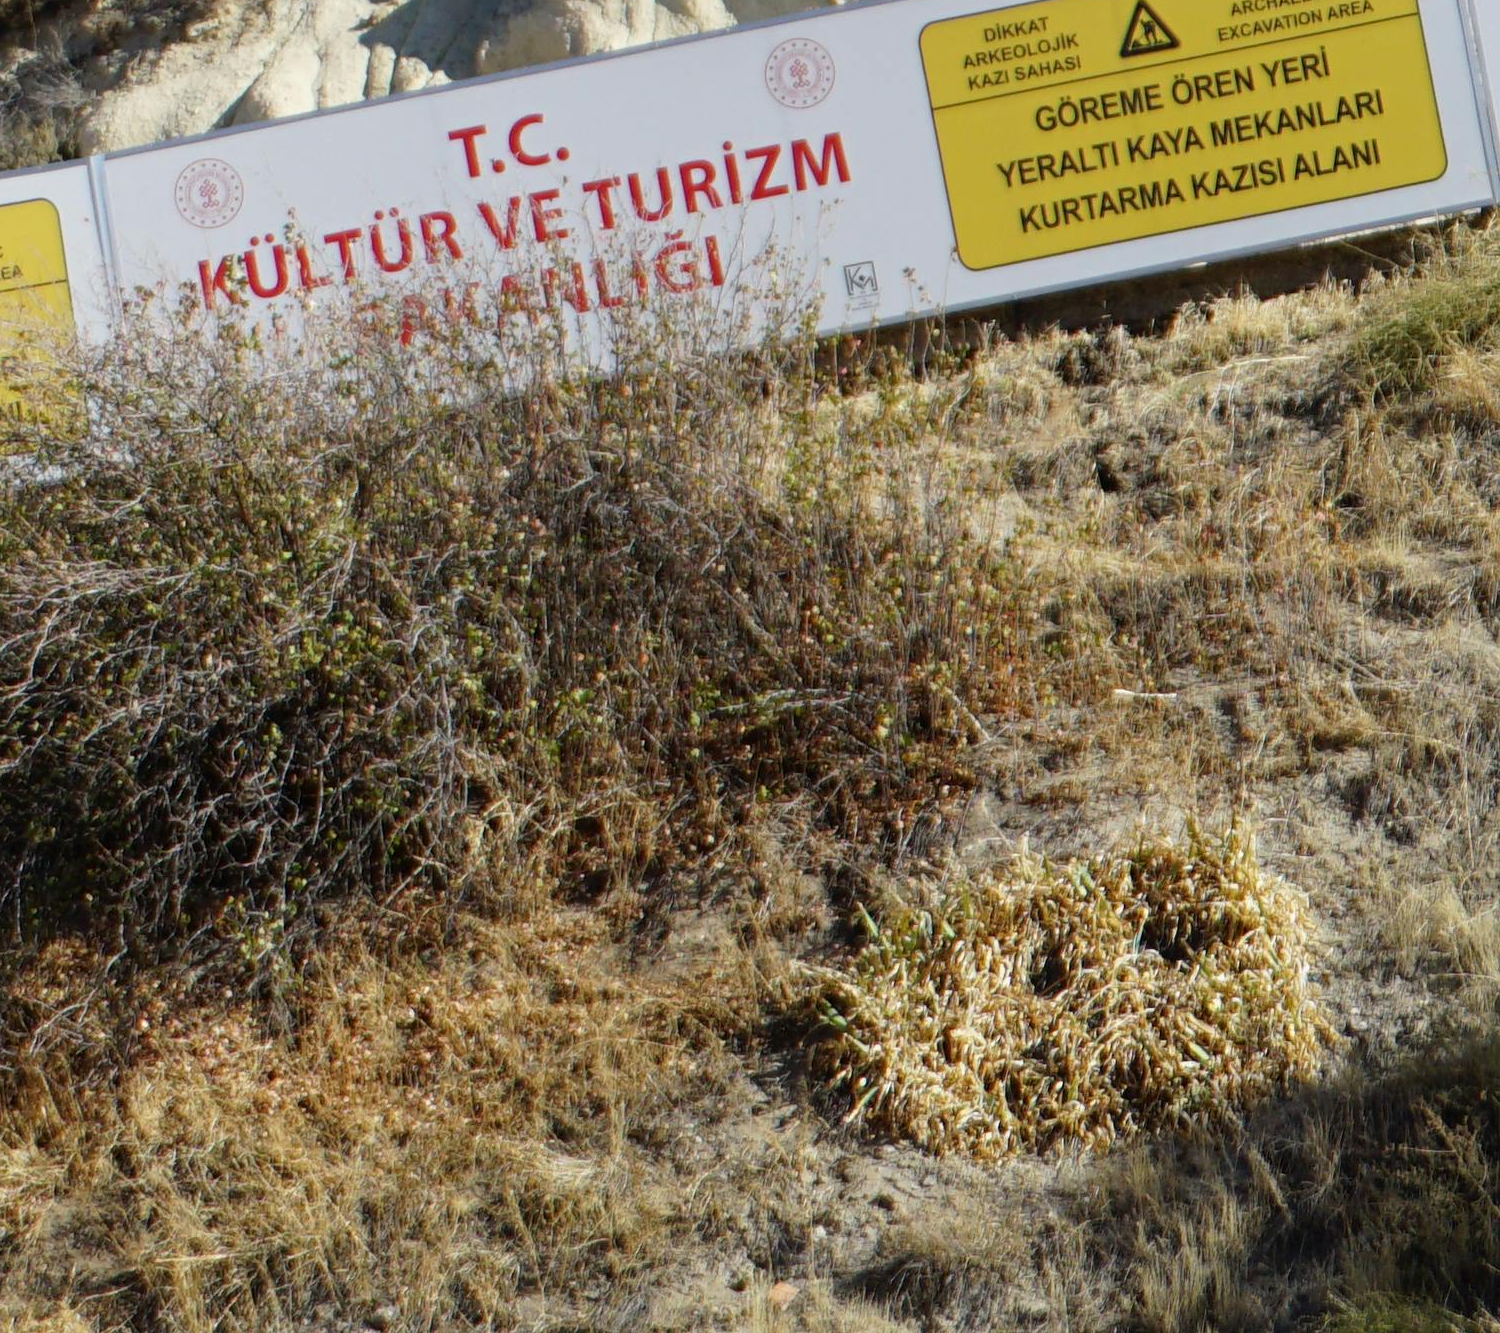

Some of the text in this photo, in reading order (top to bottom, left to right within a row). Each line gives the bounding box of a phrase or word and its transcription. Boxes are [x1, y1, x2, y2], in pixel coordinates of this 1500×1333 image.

[963, 34, 1078, 69] ARKEOLOJİK
[983, 17, 1047, 42] DİKKAT
[1217, 0, 1373, 41] EXCAVATION AREA
[968, 56, 1080, 90] KAZI SAHASI
[1035, 46, 1330, 132] GÖREME ÖREN YERİ
[448, 114, 569, 178] T.C.
[996, 89, 1383, 187] YERALTI KAYA MEKANLARI
[1018, 139, 1380, 233] KURTARMA KAZISI ALANI
[199, 133, 851, 310] KÜLTÜR VE TURİZM
